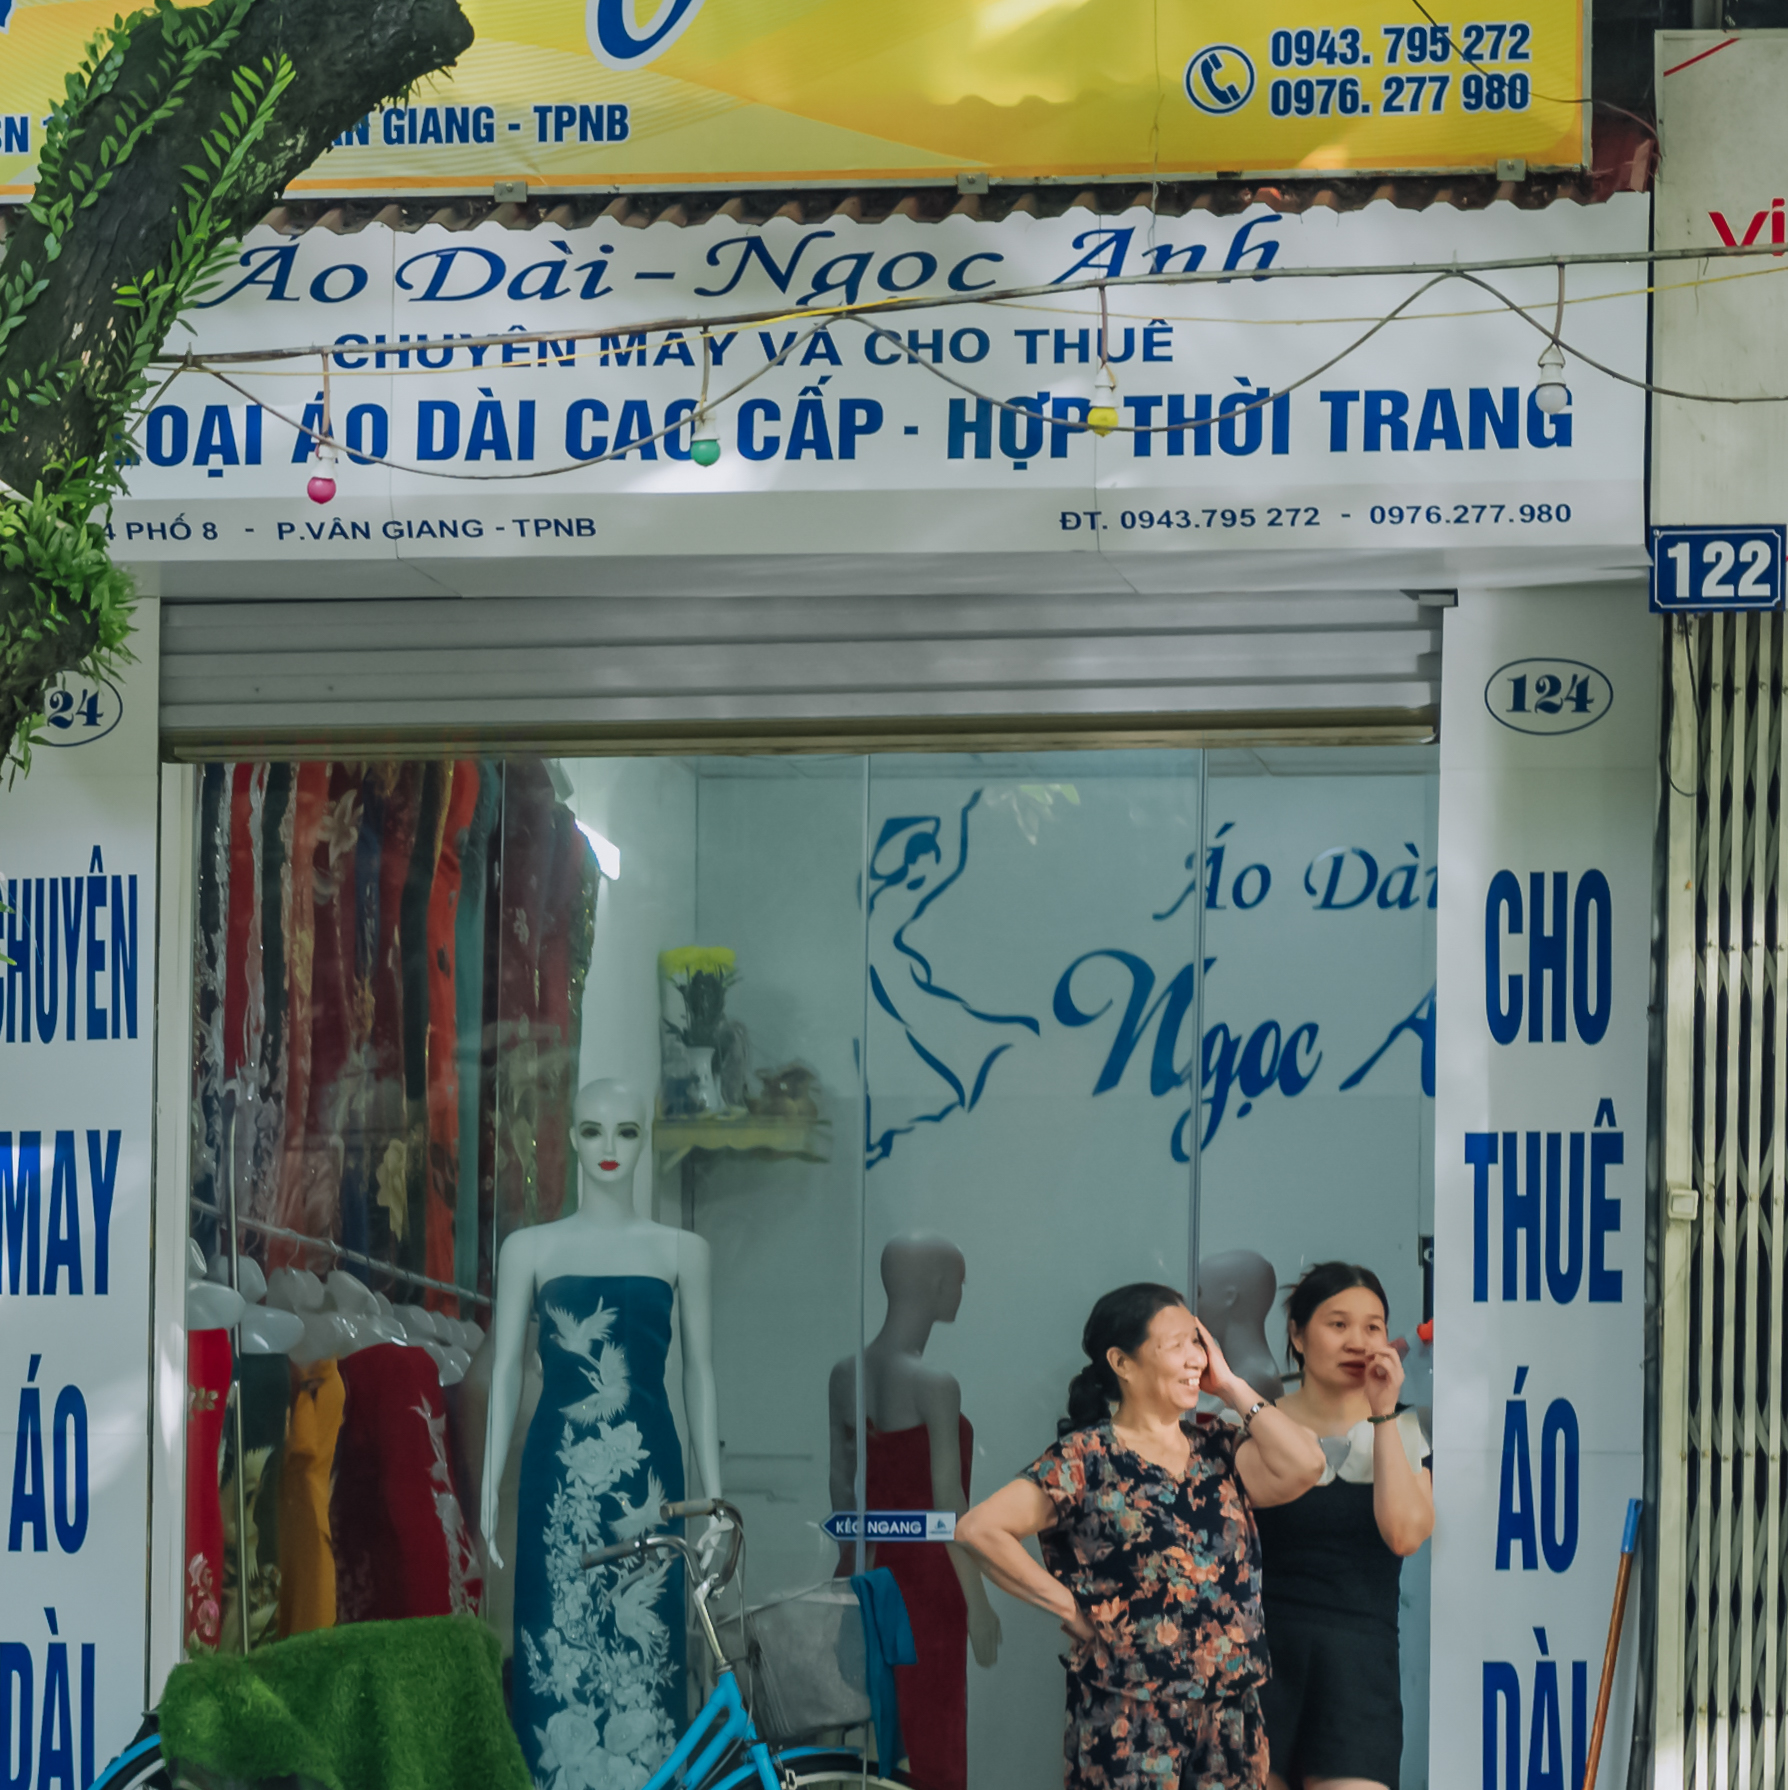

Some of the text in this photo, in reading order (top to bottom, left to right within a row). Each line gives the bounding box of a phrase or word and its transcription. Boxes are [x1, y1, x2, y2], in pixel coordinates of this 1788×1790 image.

[1271, 22, 1530, 67] 0943. 795 272
[1271, 73, 1530, 117] 0976. 277 980
[383, 106, 494, 145] GIANG
[533, 104, 630, 143] TPNB
[195, 236, 368, 308] Áo
[395, 240, 614, 303] Dài
[332, 325, 576, 368] CHUYÊN
[600, 332, 740, 367] MAY
[864, 328, 991, 366] CHO
[1015, 319, 1174, 364] THUÊ
[114, 404, 262, 478] OẠI
[292, 389, 389, 465] ÁO
[417, 387, 536, 461] DÀI
[564, 397, 702, 462] CAO
[737, 376, 884, 461] CẤP
[947, 391, 1092, 471] HỢP
[1123, 377, 1290, 458] THỜI
[1320, 387, 1573, 452] TRANG
[126, 512, 192, 541] PHỐ
[202, 521, 219, 541] 8
[277, 515, 369, 541] P.VÂN
[383, 518, 483, 541] GIANG
[513, 518, 597, 539] TPNB
[1059, 511, 1108, 532] ĐT.
[1120, 506, 1257, 531] 0943.795
[1266, 506, 1321, 528] 272
[1369, 503, 1572, 527] 0976.277.980
[1667, 540, 1772, 598] 122
[47, 689, 104, 729] 24
[1505, 673, 1595, 715] 124
[1152, 822, 1272, 921] Áo
[1485, 869, 1612, 1045] CHO
[1053, 949, 1322, 1162] Ngọc
[1465, 1097, 1625, 1305] THUÊ
[8, 1353, 89, 1555] ÁO
[1495, 1365, 1579, 1574] ÁO
[867, 1520, 922, 1535] NGANG
